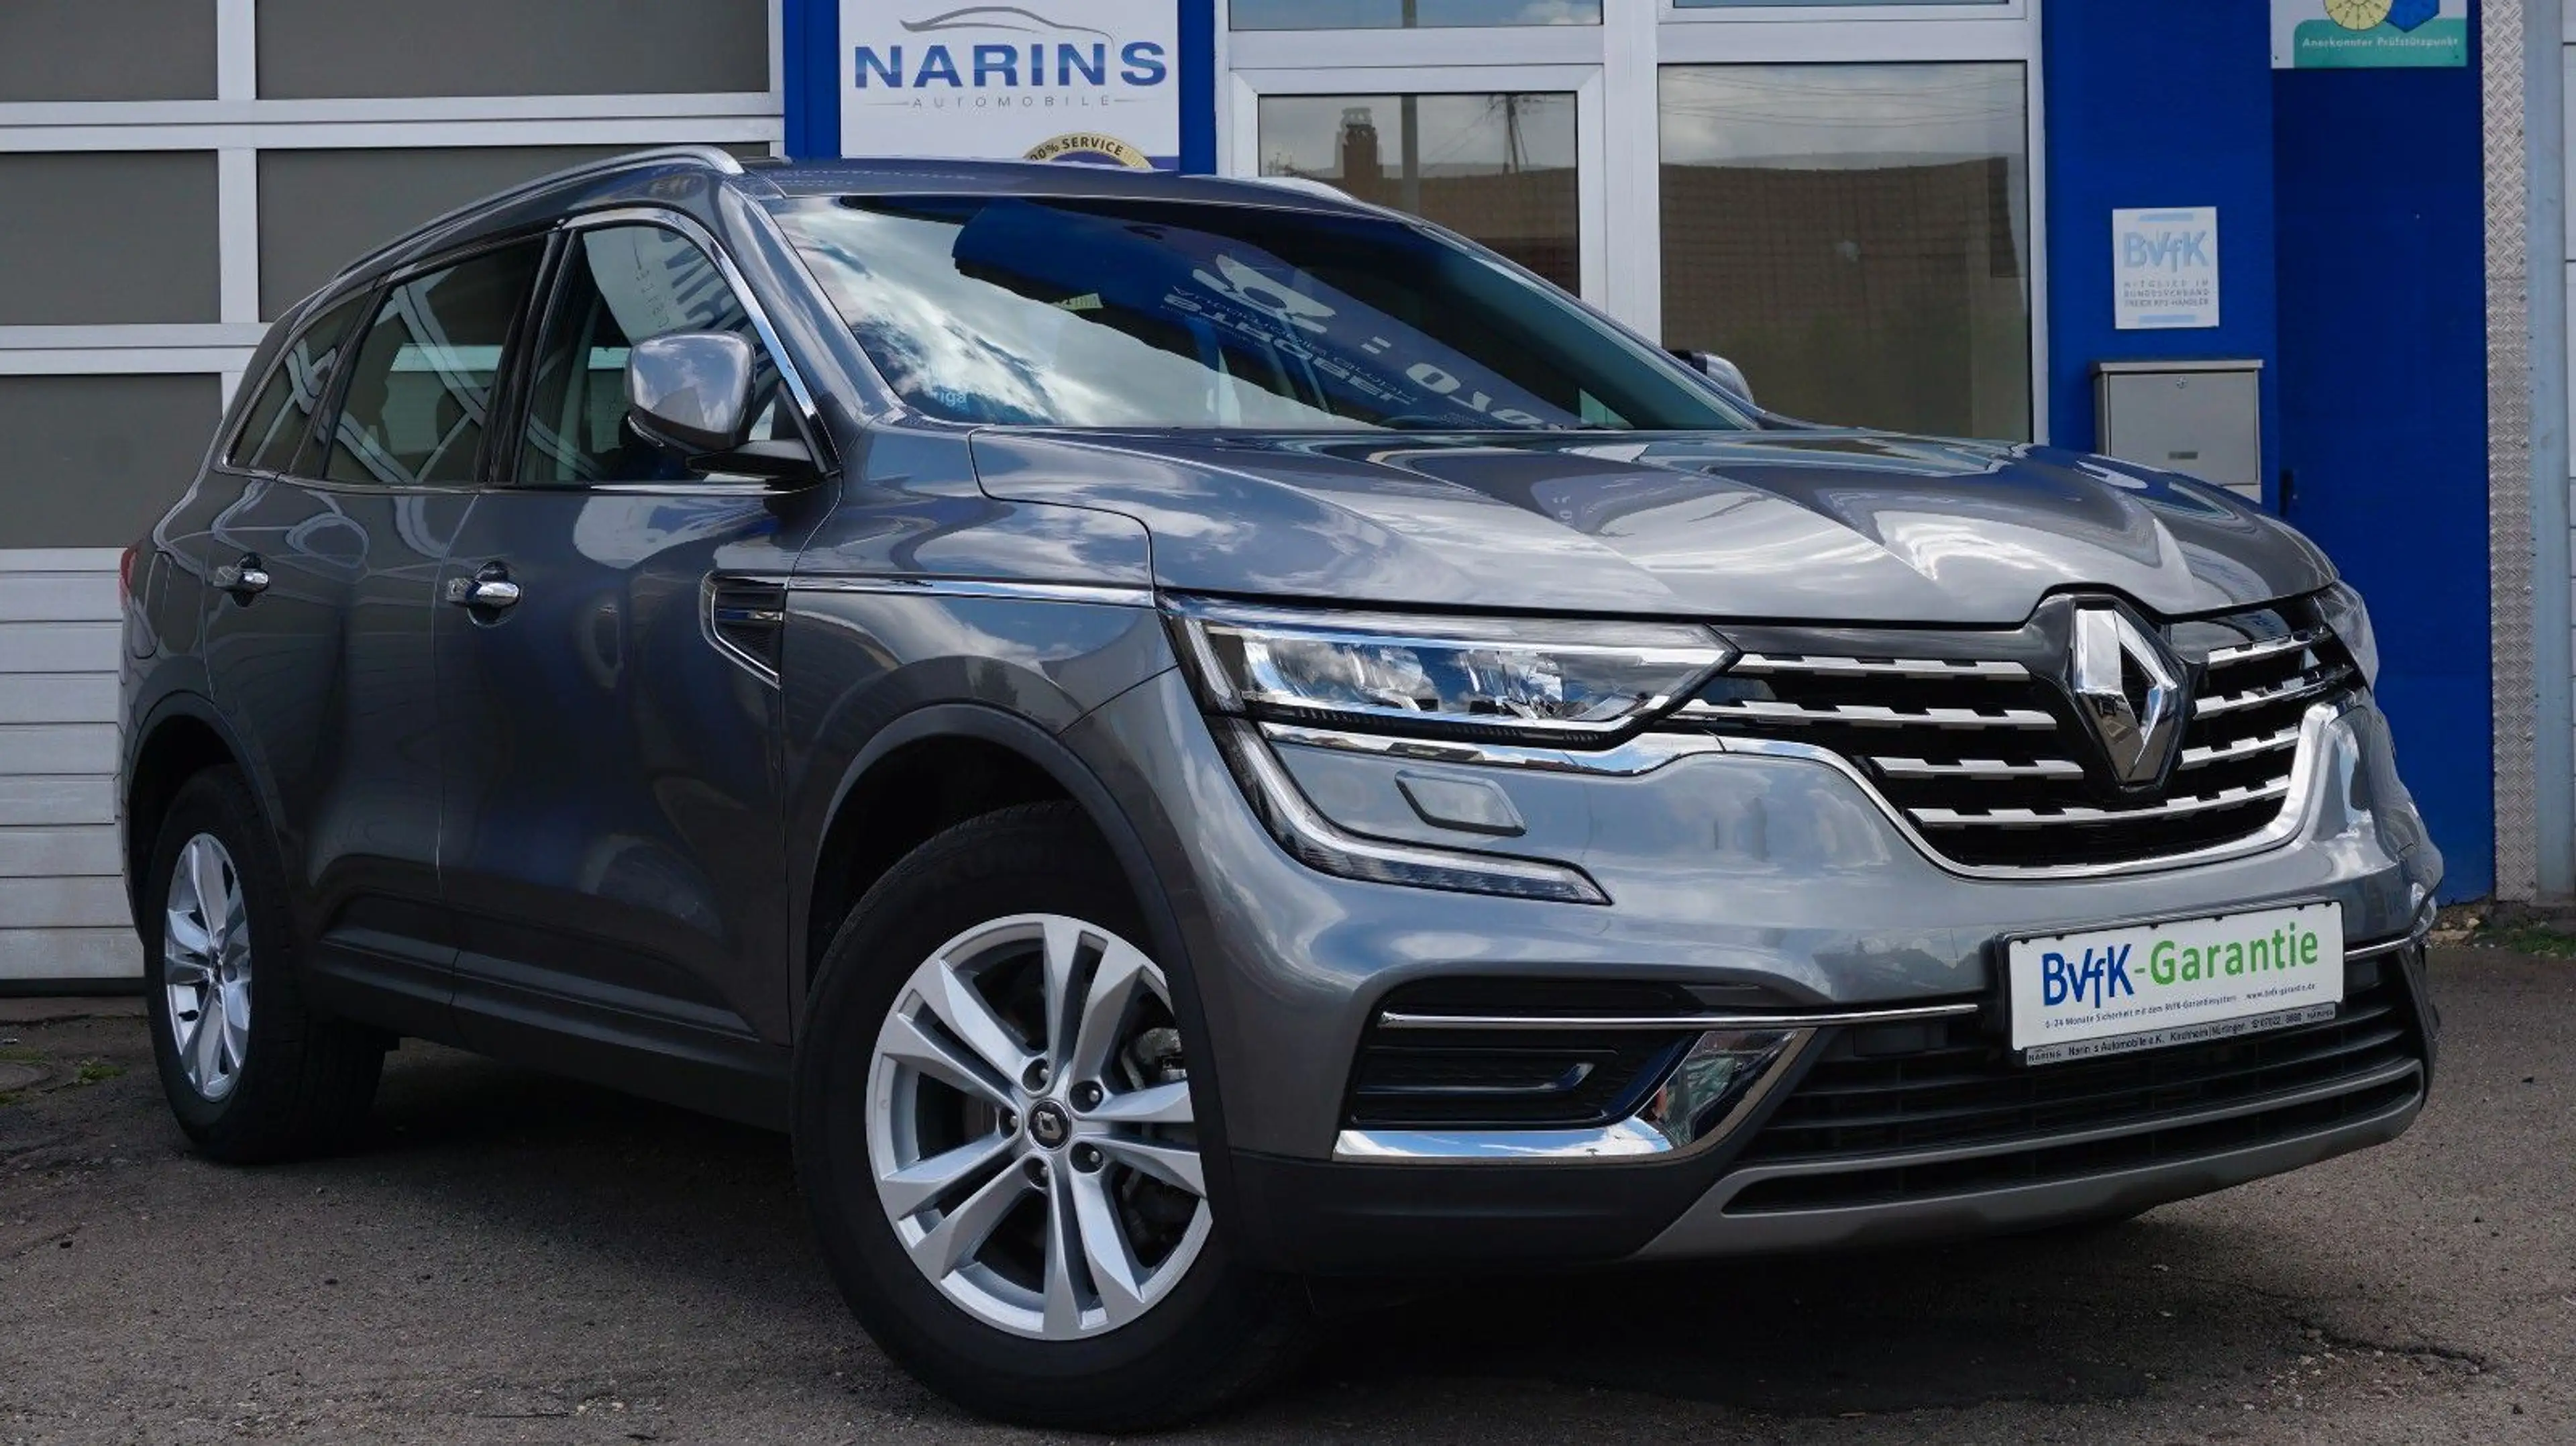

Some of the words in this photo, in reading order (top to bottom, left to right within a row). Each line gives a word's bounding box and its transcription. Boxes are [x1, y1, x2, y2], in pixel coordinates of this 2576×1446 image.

[2302, 38, 2373, 47] Anerkannter
[854, 42, 1167, 89] NARINS
[912, 95, 1110, 108] AUTOMOBILE
[1061, 136, 1124, 156] SERVICE
[2123, 231, 2210, 273] BVfK
[2041, 922, 2318, 1008] BVfK-Garantie
